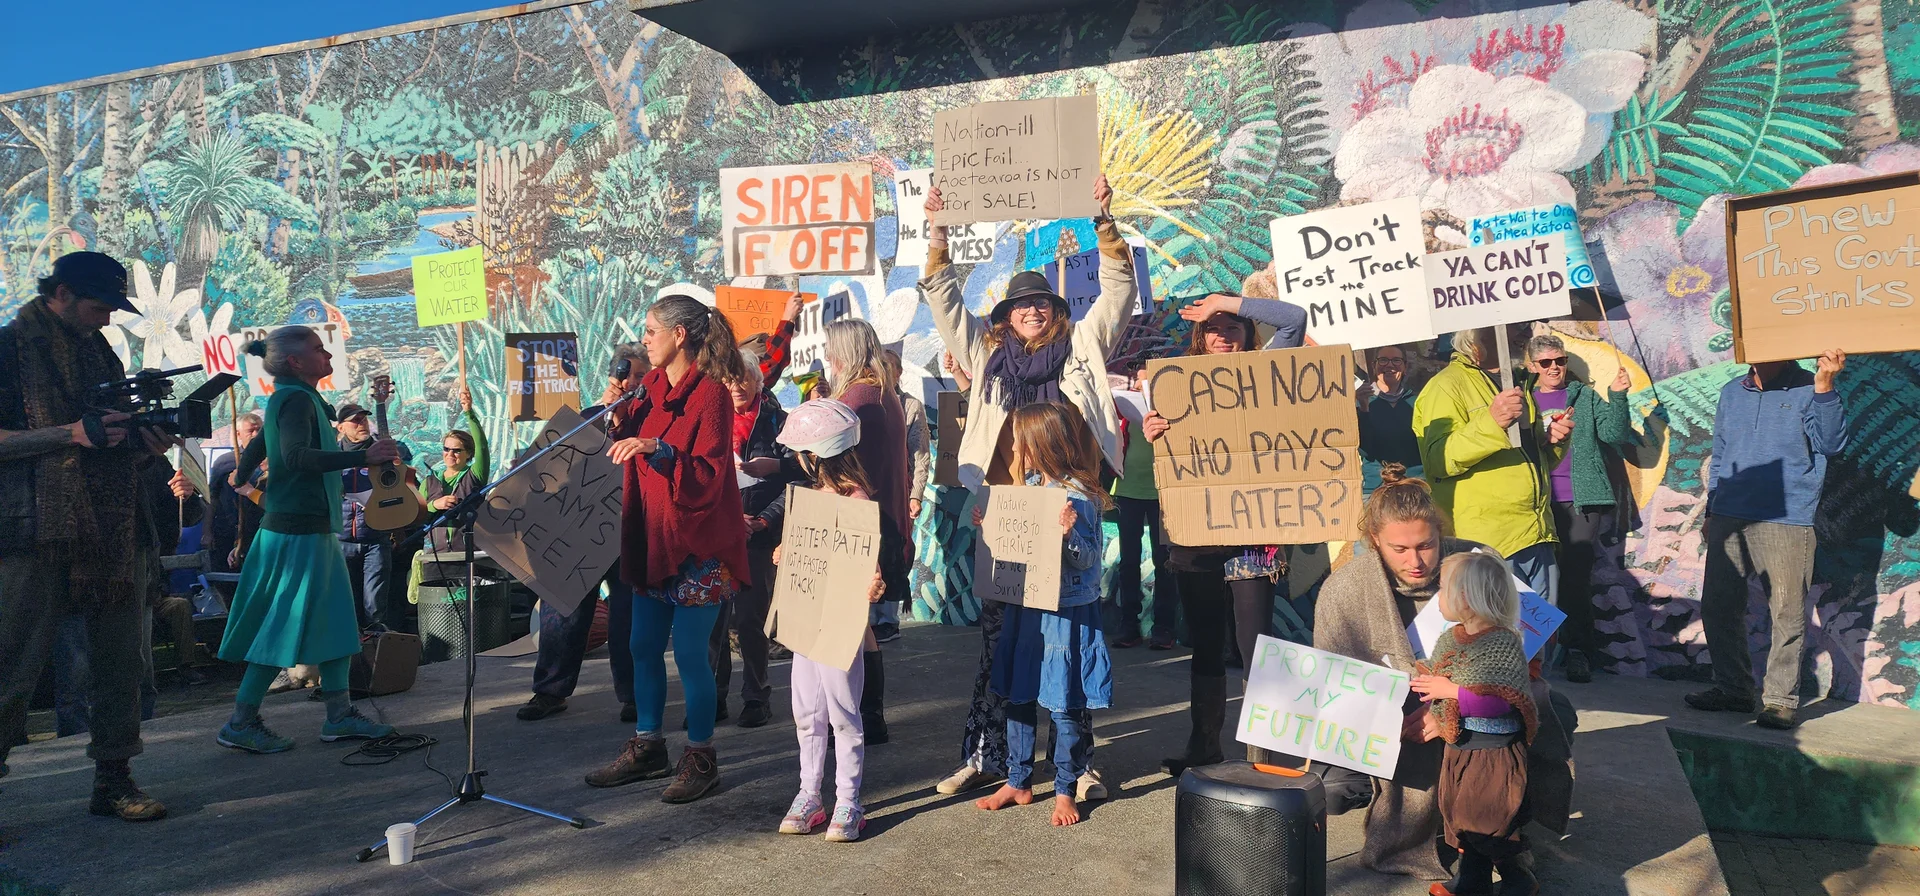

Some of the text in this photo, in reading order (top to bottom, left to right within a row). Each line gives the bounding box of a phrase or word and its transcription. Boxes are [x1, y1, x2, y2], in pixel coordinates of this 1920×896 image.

[943, 114, 1034, 142] Nation-ill
[940, 148, 979, 171] Epic
[898, 178, 922, 197] The
[938, 171, 1022, 189] Aoetearoa
[1027, 168, 1040, 182] is
[1047, 167, 1082, 180] NOT
[736, 173, 870, 226] SIREN
[943, 191, 1036, 211] for SALE!
[1492, 215, 1507, 228] te
[1509, 212, 1528, 225] Wai
[1532, 207, 1549, 222] te
[1763, 198, 1896, 244] Phew
[900, 223, 917, 241] the
[1298, 213, 1401, 260] Don't
[789, 226, 864, 271] OFF
[951, 237, 993, 261] MESS
[1443, 240, 1550, 278] YA CAN'T
[1743, 243, 1822, 278] This
[428, 257, 477, 280] PROTECT
[1284, 252, 1422, 294] Fast Track
[443, 278, 468, 293] OUR
[1340, 282, 1365, 292] the
[1433, 271, 1565, 310] DRINK GOLD
[1770, 275, 1916, 316] Stinks
[429, 295, 480, 317] WATER
[726, 291, 774, 313] LEAVE
[1309, 287, 1405, 328] MINE
[202, 334, 236, 375] NO
[516, 339, 568, 363] STOP
[793, 344, 819, 369] FAST
[526, 363, 558, 378] THE
[508, 377, 580, 396] FAST TRACK
[1150, 354, 1347, 425] CASH NOW
[1164, 428, 1346, 481] WHO PAYS
[535, 428, 623, 516] SAVE
[996, 493, 1028, 512] Nature
[1205, 478, 1348, 531] LATER?
[998, 515, 1040, 537] needs to
[486, 495, 599, 592] CREEK
[795, 526, 828, 548] BETTER
[832, 529, 872, 557] PATH
[803, 555, 828, 577] FASTER
[1259, 643, 1407, 701] PROTECT
[1294, 687, 1342, 709] MY
[1247, 703, 1388, 769] FUTURE
